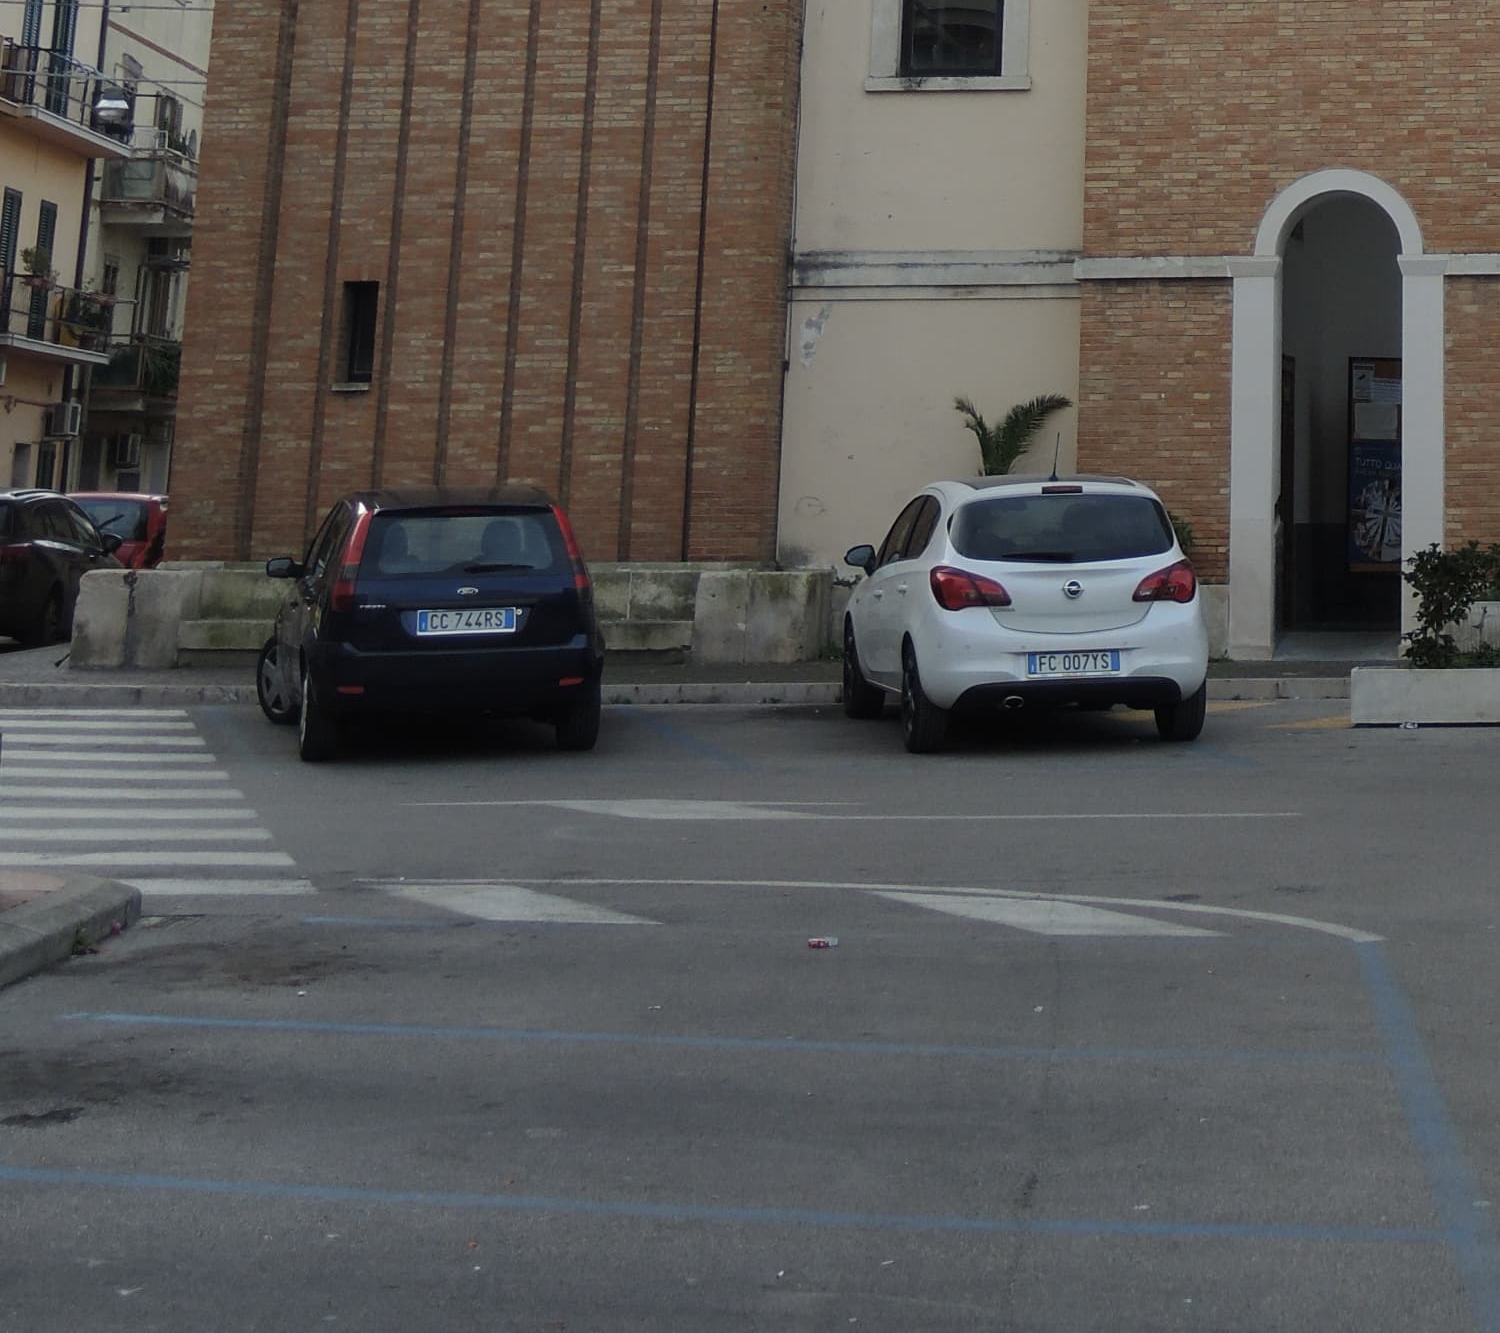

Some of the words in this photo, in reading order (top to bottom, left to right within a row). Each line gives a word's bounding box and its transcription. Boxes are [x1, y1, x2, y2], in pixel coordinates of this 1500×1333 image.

[430, 614, 448, 629] CC
[455, 612, 503, 628] 744RS
[1038, 656, 1056, 671] FC
[1063, 654, 1109, 670] 007YS
